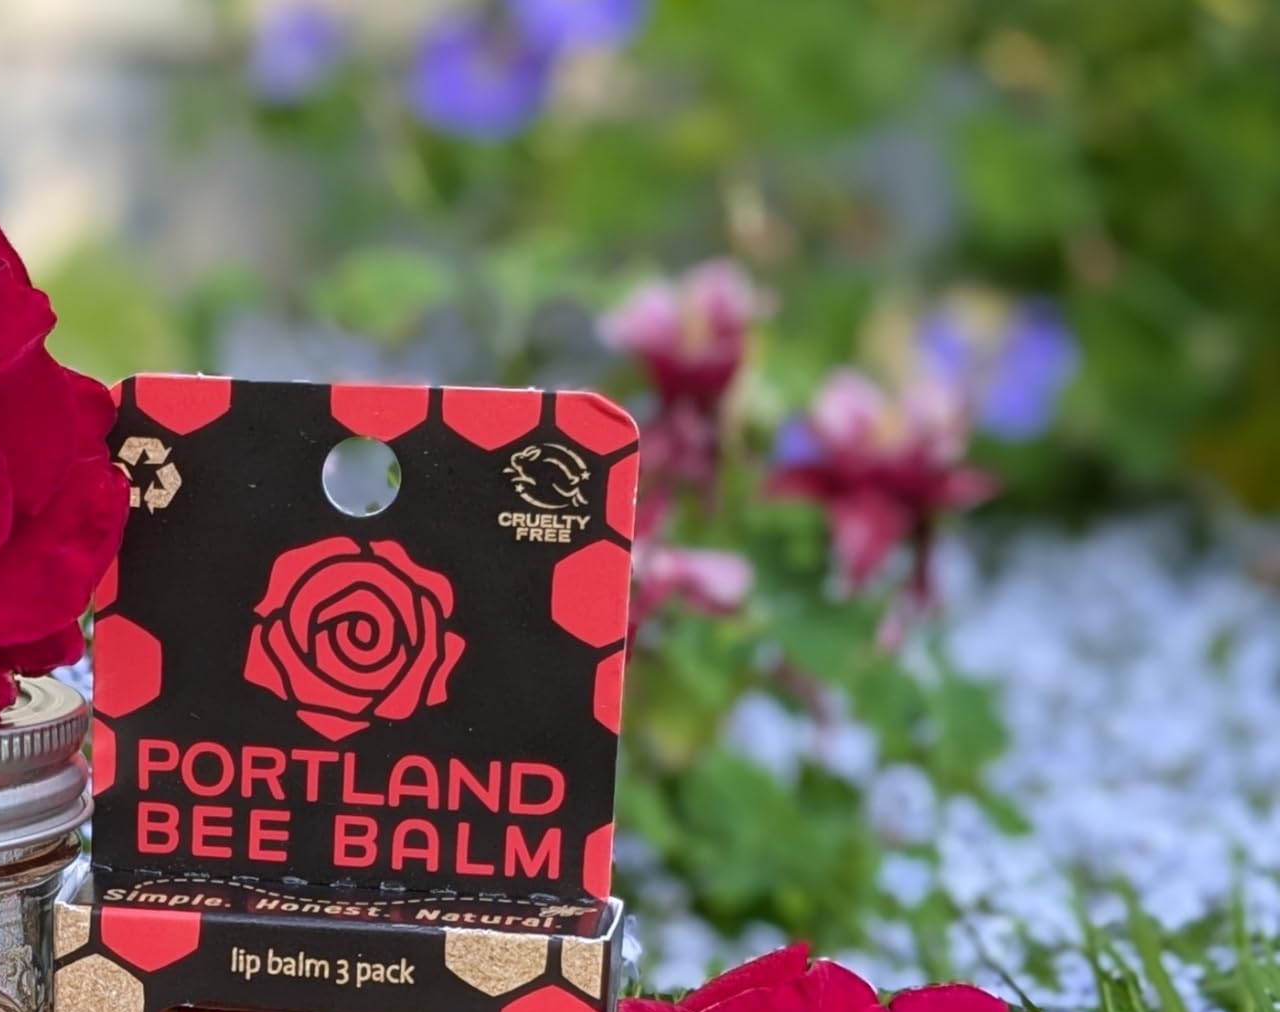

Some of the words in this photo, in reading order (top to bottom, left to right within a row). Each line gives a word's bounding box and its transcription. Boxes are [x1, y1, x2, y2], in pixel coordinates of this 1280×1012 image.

[497, 511, 591, 530] CRUELTY
[515, 526, 572, 543] FREE
[137, 739, 566, 815] PORTLAND
[137, 802, 291, 863] BEE
[333, 814, 562, 880] BALM
[103, 888, 231, 908] Simple.
[255, 898, 391, 918] Honest.
[415, 908, 562, 930] Natural.
[231, 946, 263, 980] lip
[267, 948, 330, 977] balm
[336, 959, 350, 985] 3
[355, 953, 416, 987] pack
